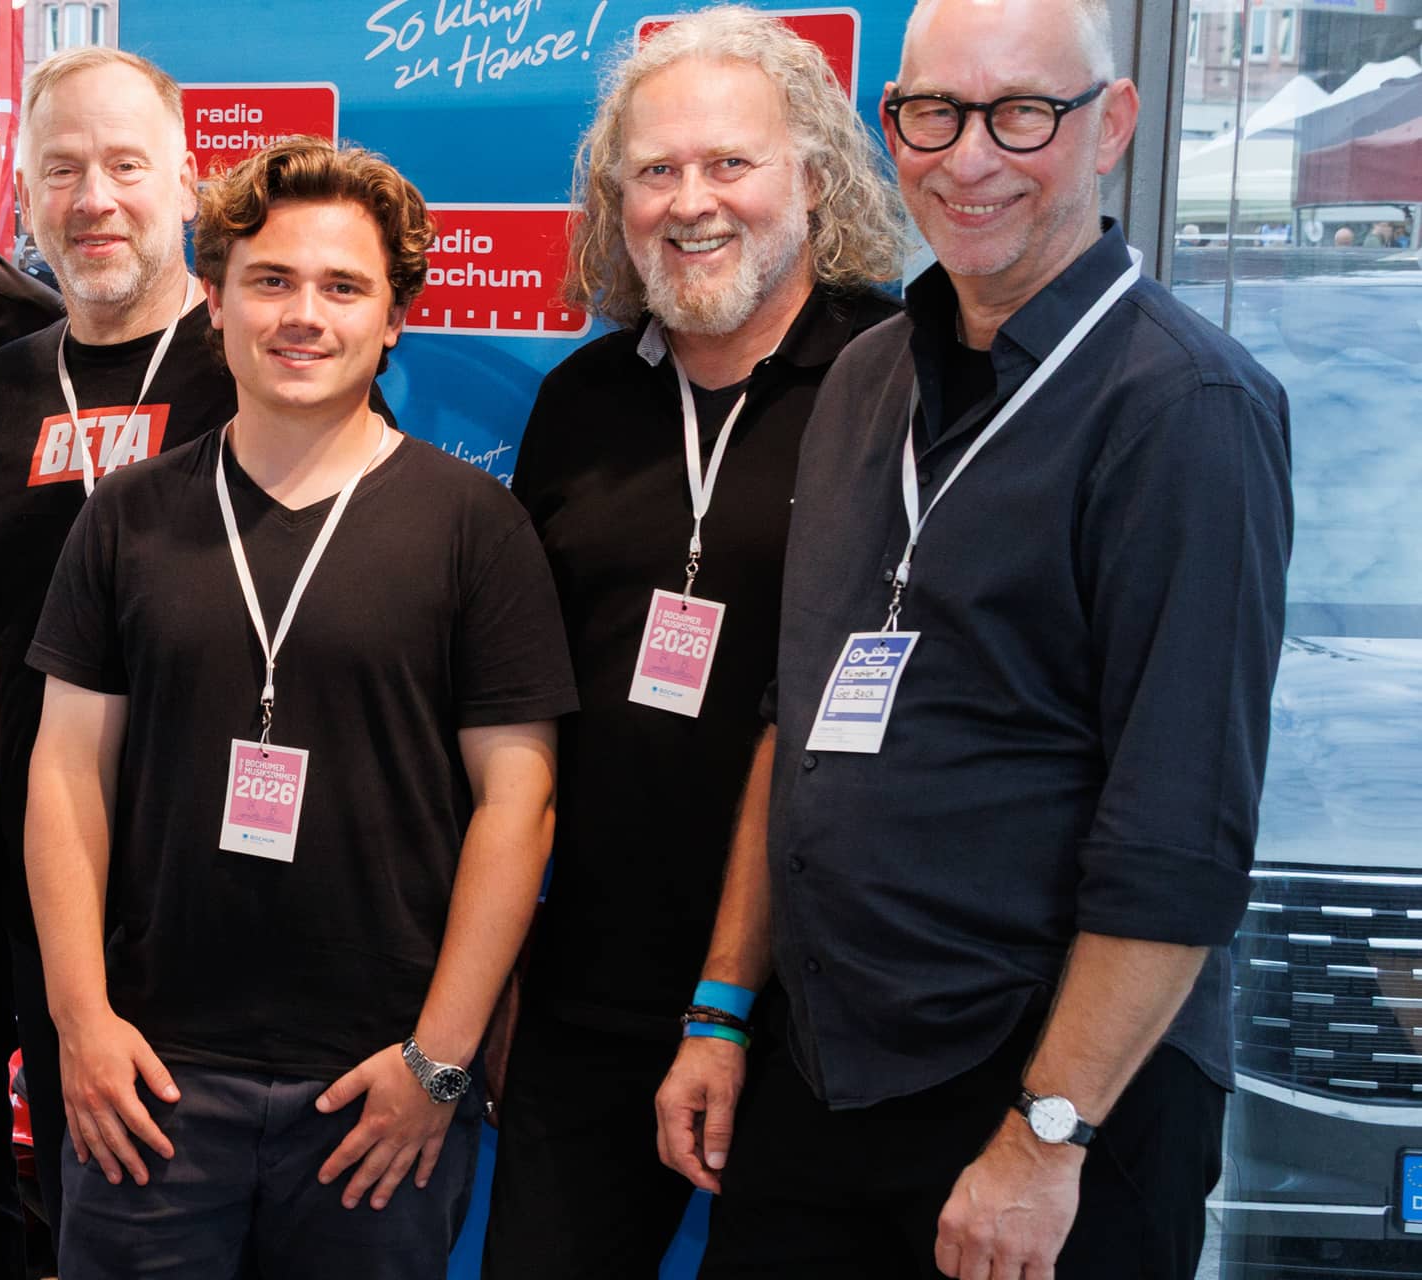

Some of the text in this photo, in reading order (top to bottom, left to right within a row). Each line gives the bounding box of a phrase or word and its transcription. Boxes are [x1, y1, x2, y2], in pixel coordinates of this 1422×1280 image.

[364, 0, 426, 61] So
[394, 0, 608, 90] zu Hause!
[196, 104, 263, 123] radio
[425, 229, 493, 254] adio
[426, 263, 542, 288] ochum
[39, 414, 151, 476] BETA
[649, 626, 709, 660] 2026
[234, 775, 296, 805] 2026
